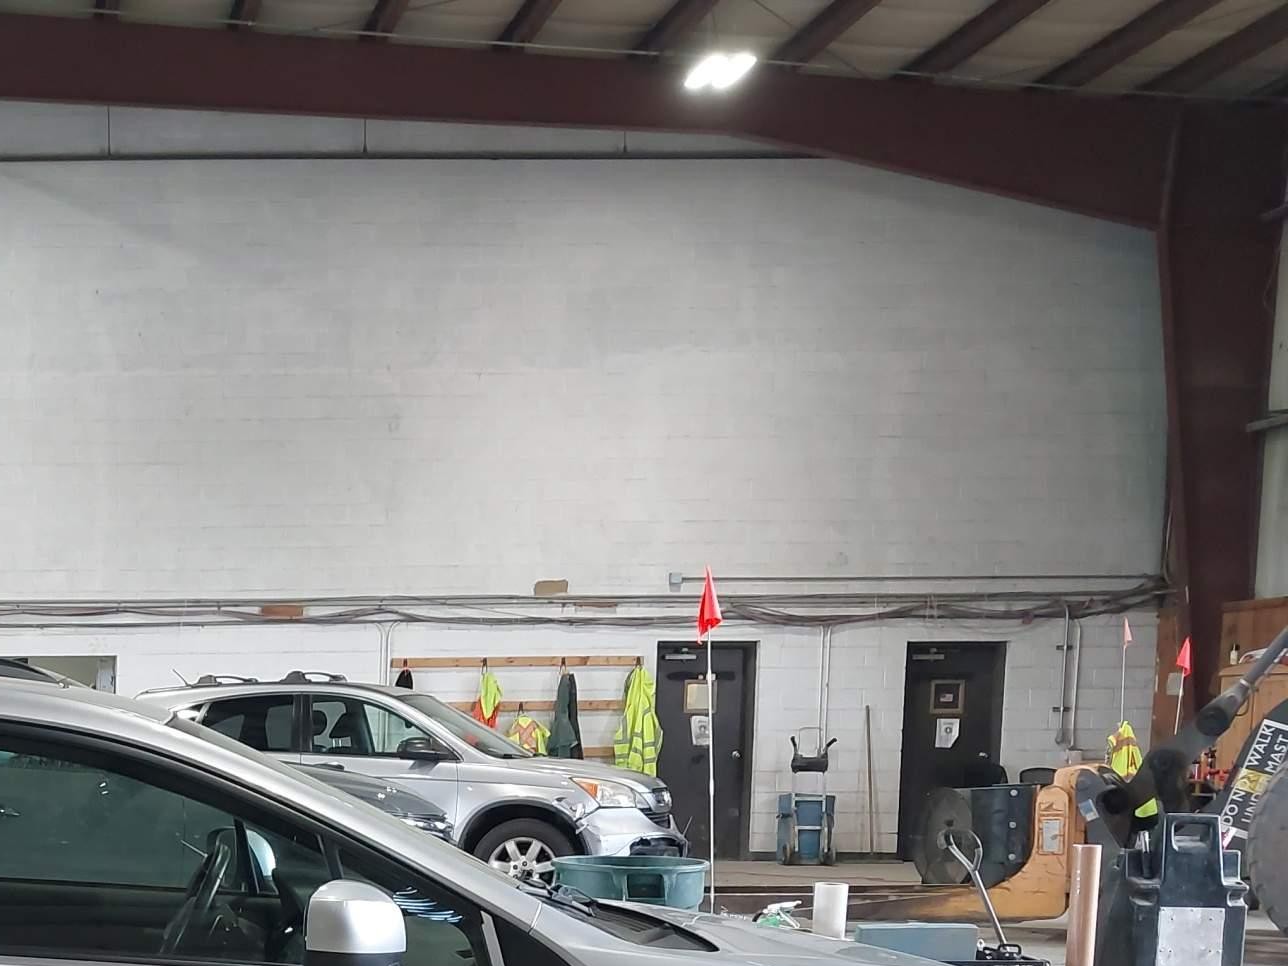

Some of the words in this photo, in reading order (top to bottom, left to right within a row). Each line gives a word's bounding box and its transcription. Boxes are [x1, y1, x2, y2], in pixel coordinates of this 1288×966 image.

[1221, 804, 1239, 826] DO
[1246, 725, 1276, 766] WALK
[1264, 733, 1288, 773] MAST
